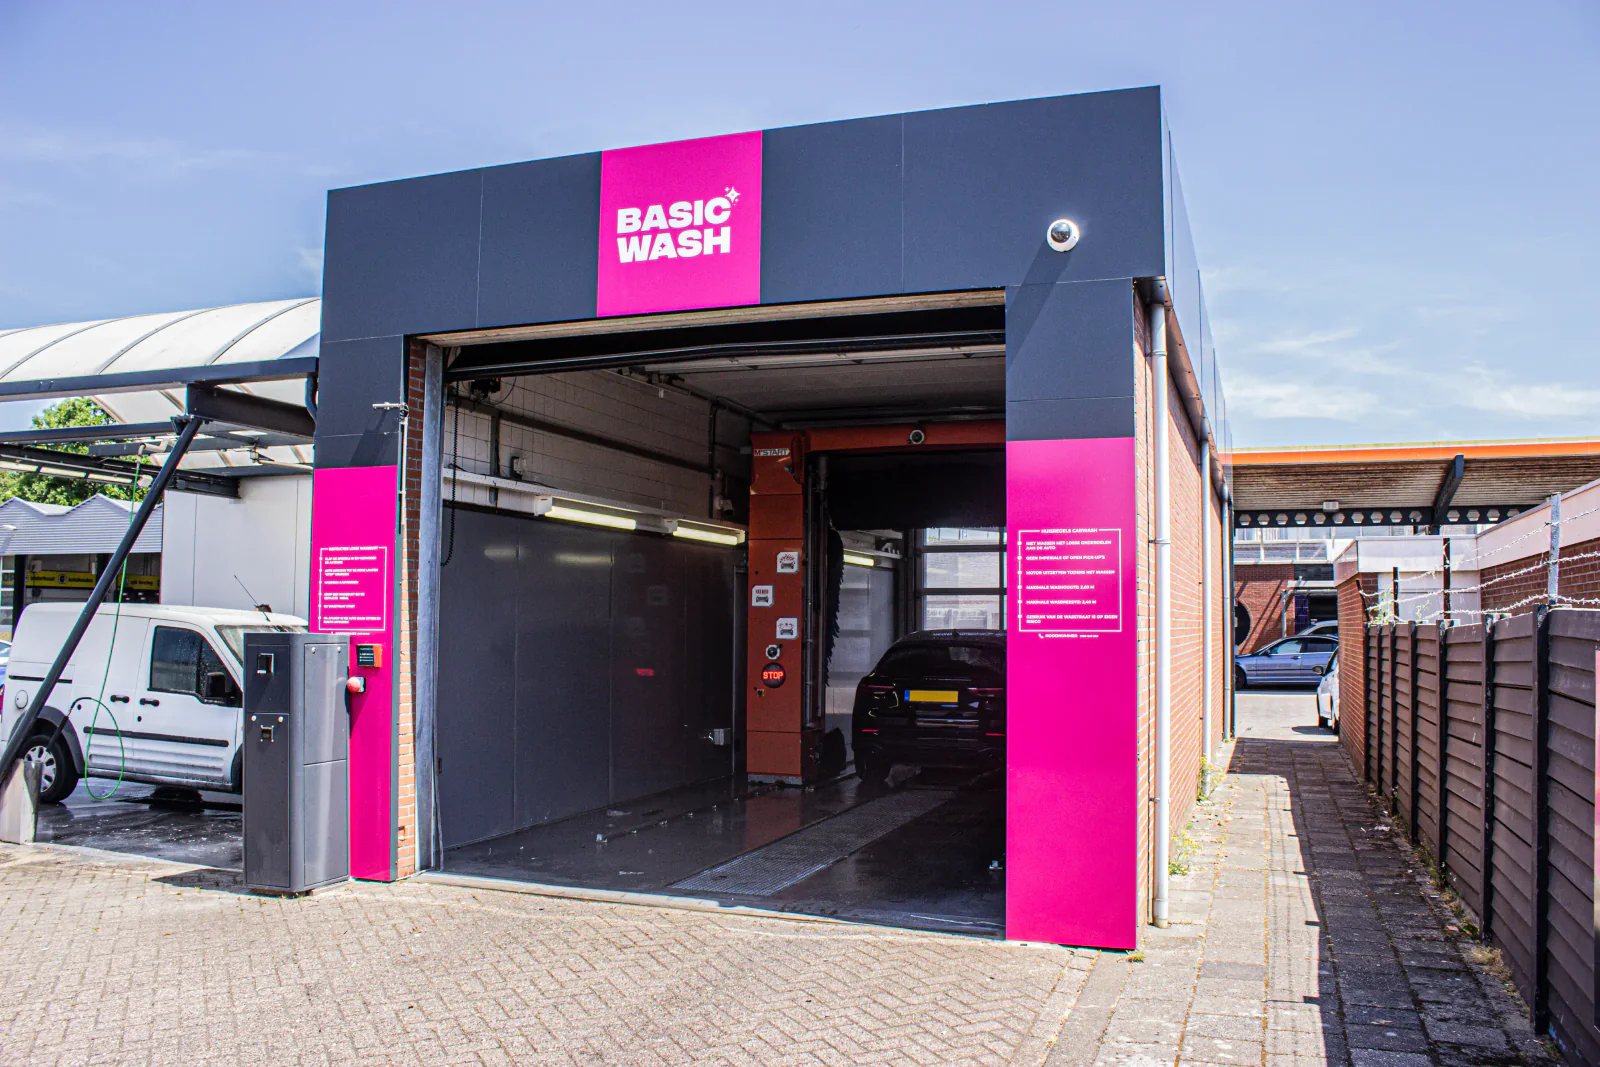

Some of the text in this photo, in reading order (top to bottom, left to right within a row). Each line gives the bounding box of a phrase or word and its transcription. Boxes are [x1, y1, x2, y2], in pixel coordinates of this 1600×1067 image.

[617, 197, 731, 234] BASIC
[616, 226, 731, 264] WASH
[763, 672, 784, 680] STOP
